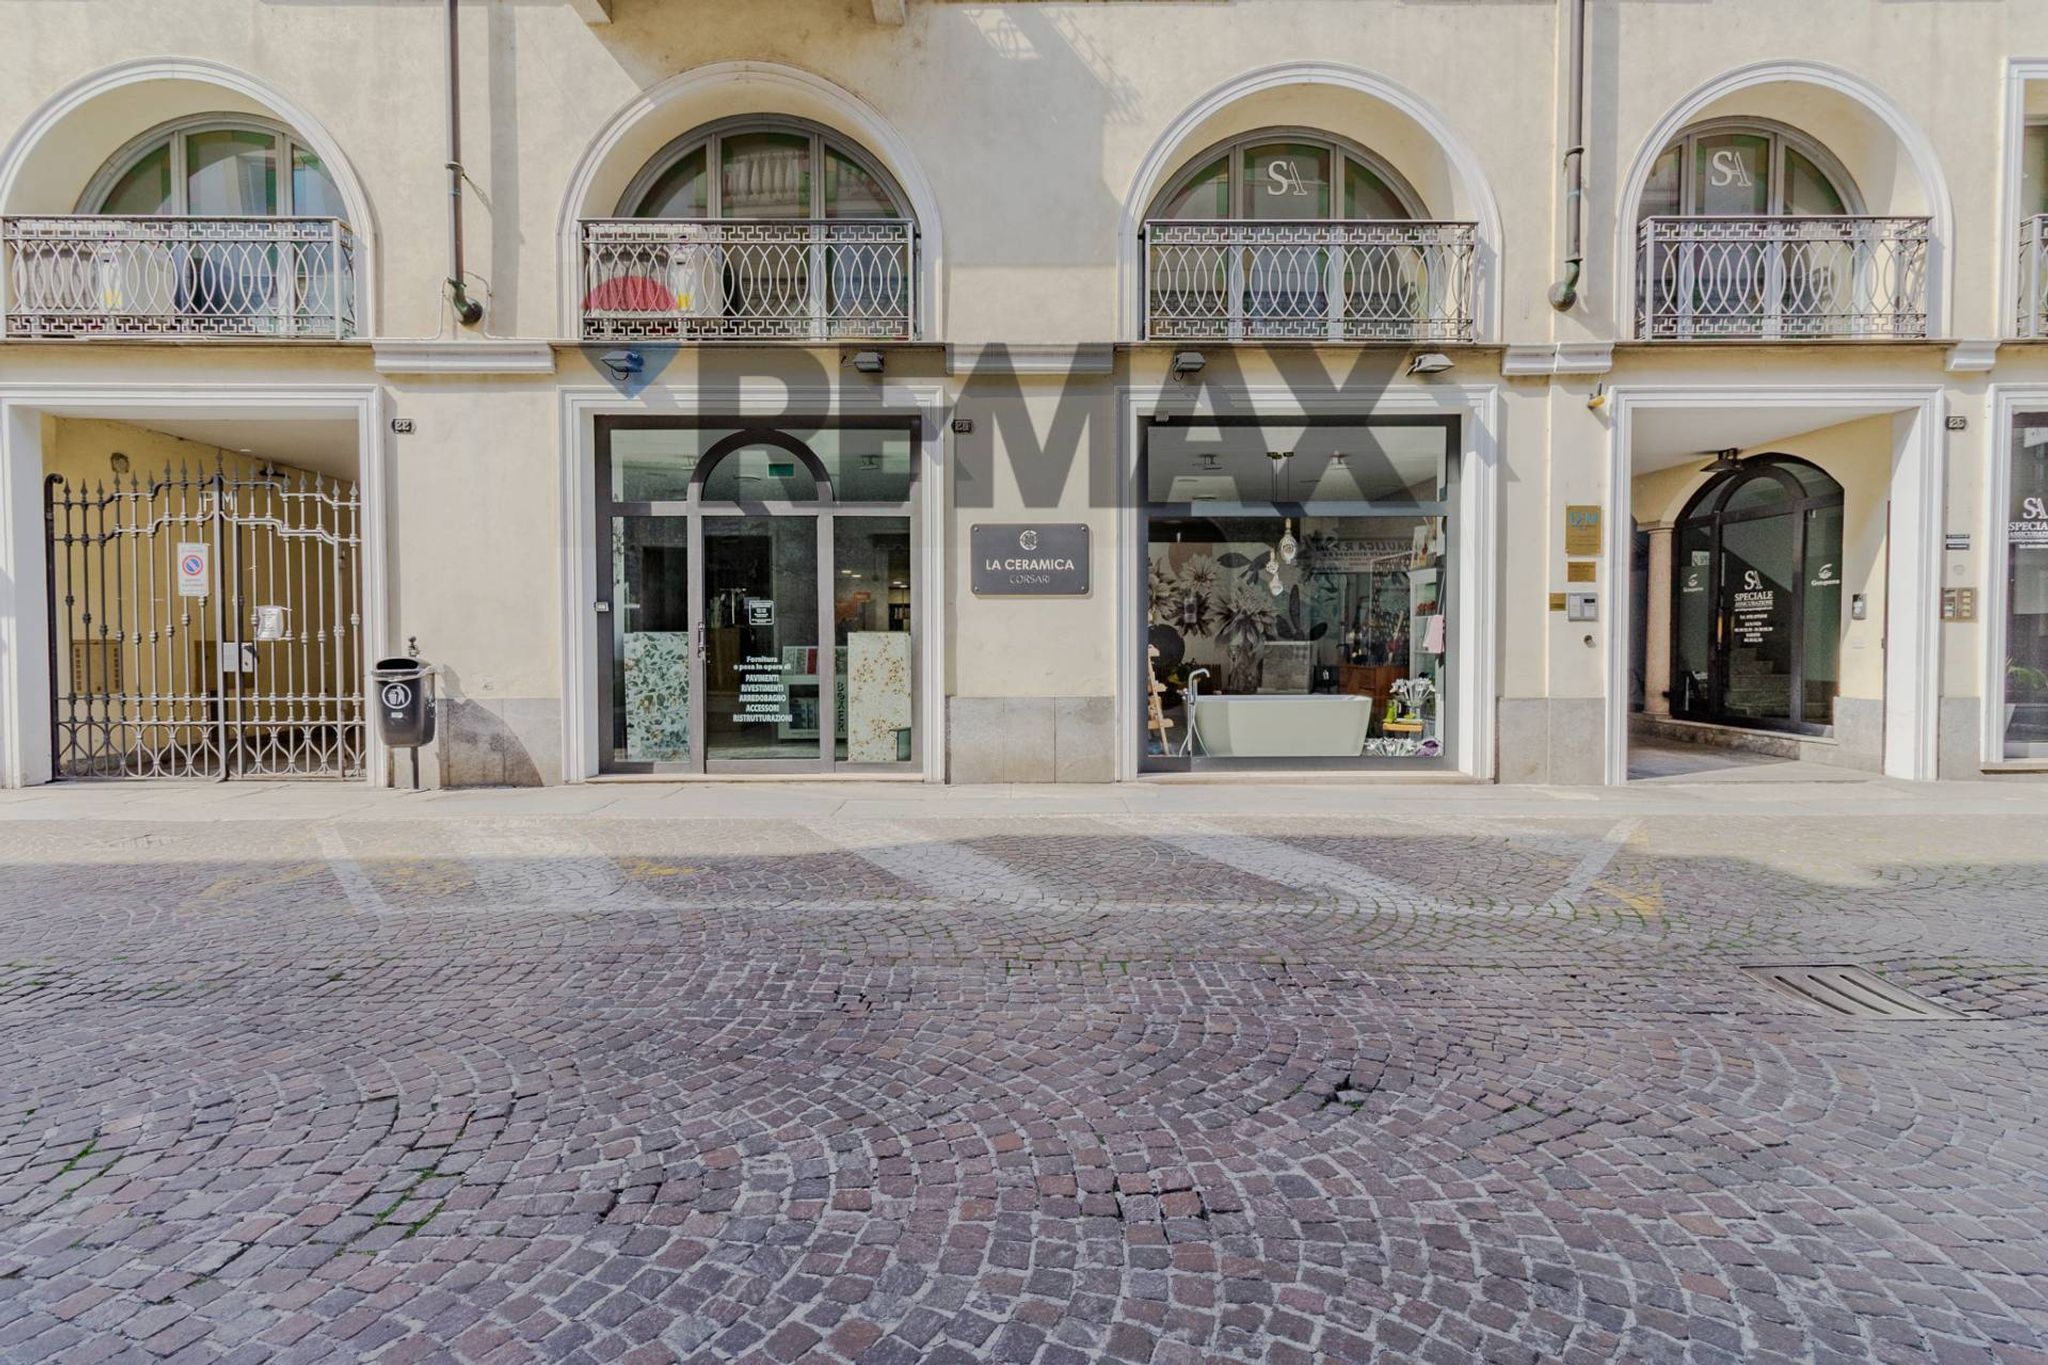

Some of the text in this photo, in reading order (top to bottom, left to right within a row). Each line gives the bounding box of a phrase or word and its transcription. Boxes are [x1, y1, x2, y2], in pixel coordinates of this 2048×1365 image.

[1711, 150, 1752, 186] SA
[1267, 160, 1307, 196] SA
[395, 419, 411, 431] 22
[985, 559, 1075, 570] LA CERAMICA
[1744, 570, 1763, 590] SA
[1734, 590, 1774, 601] SPECIALE
[746, 655, 778, 663] Fornitura
[745, 674, 779, 682] PAVIMENTI
[741, 684, 784, 692] RIVESTIMENTI
[739, 694, 787, 703] ARREDOBAGNO
[745, 704, 780, 713] ACCESSORI
[733, 714, 793, 722] RISTRUTTURAZIONI
